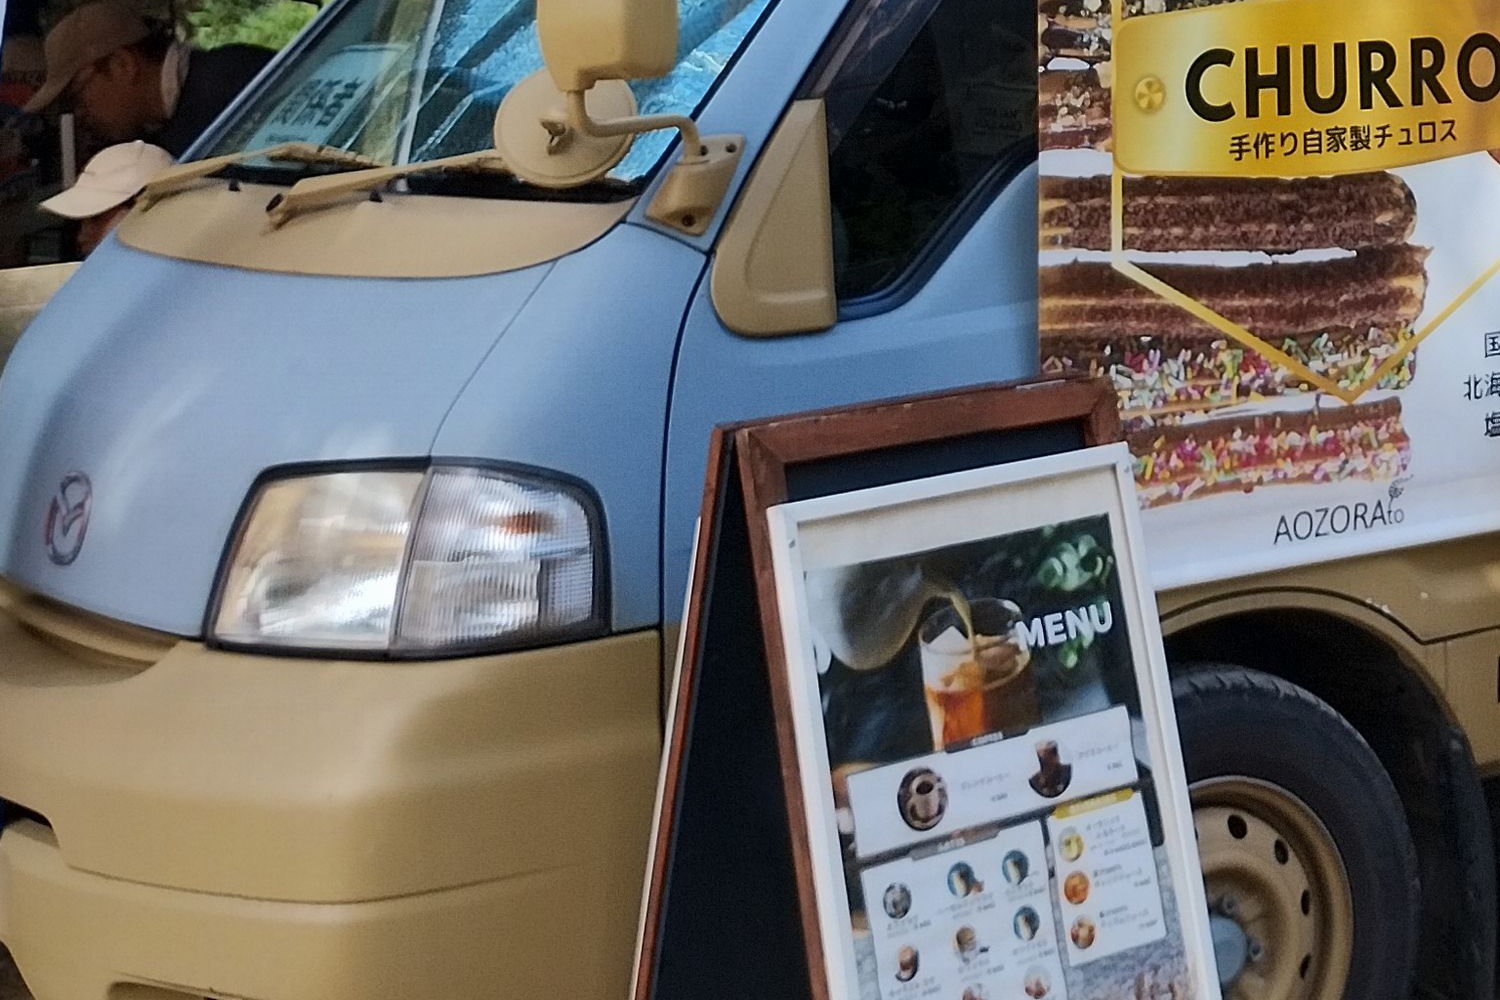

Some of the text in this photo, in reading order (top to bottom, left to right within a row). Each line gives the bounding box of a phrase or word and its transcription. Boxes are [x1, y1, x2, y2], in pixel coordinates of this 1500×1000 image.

[1228, 118, 1458, 163] 手作り自家製チュロス
[1015, 601, 1113, 651] MENU
